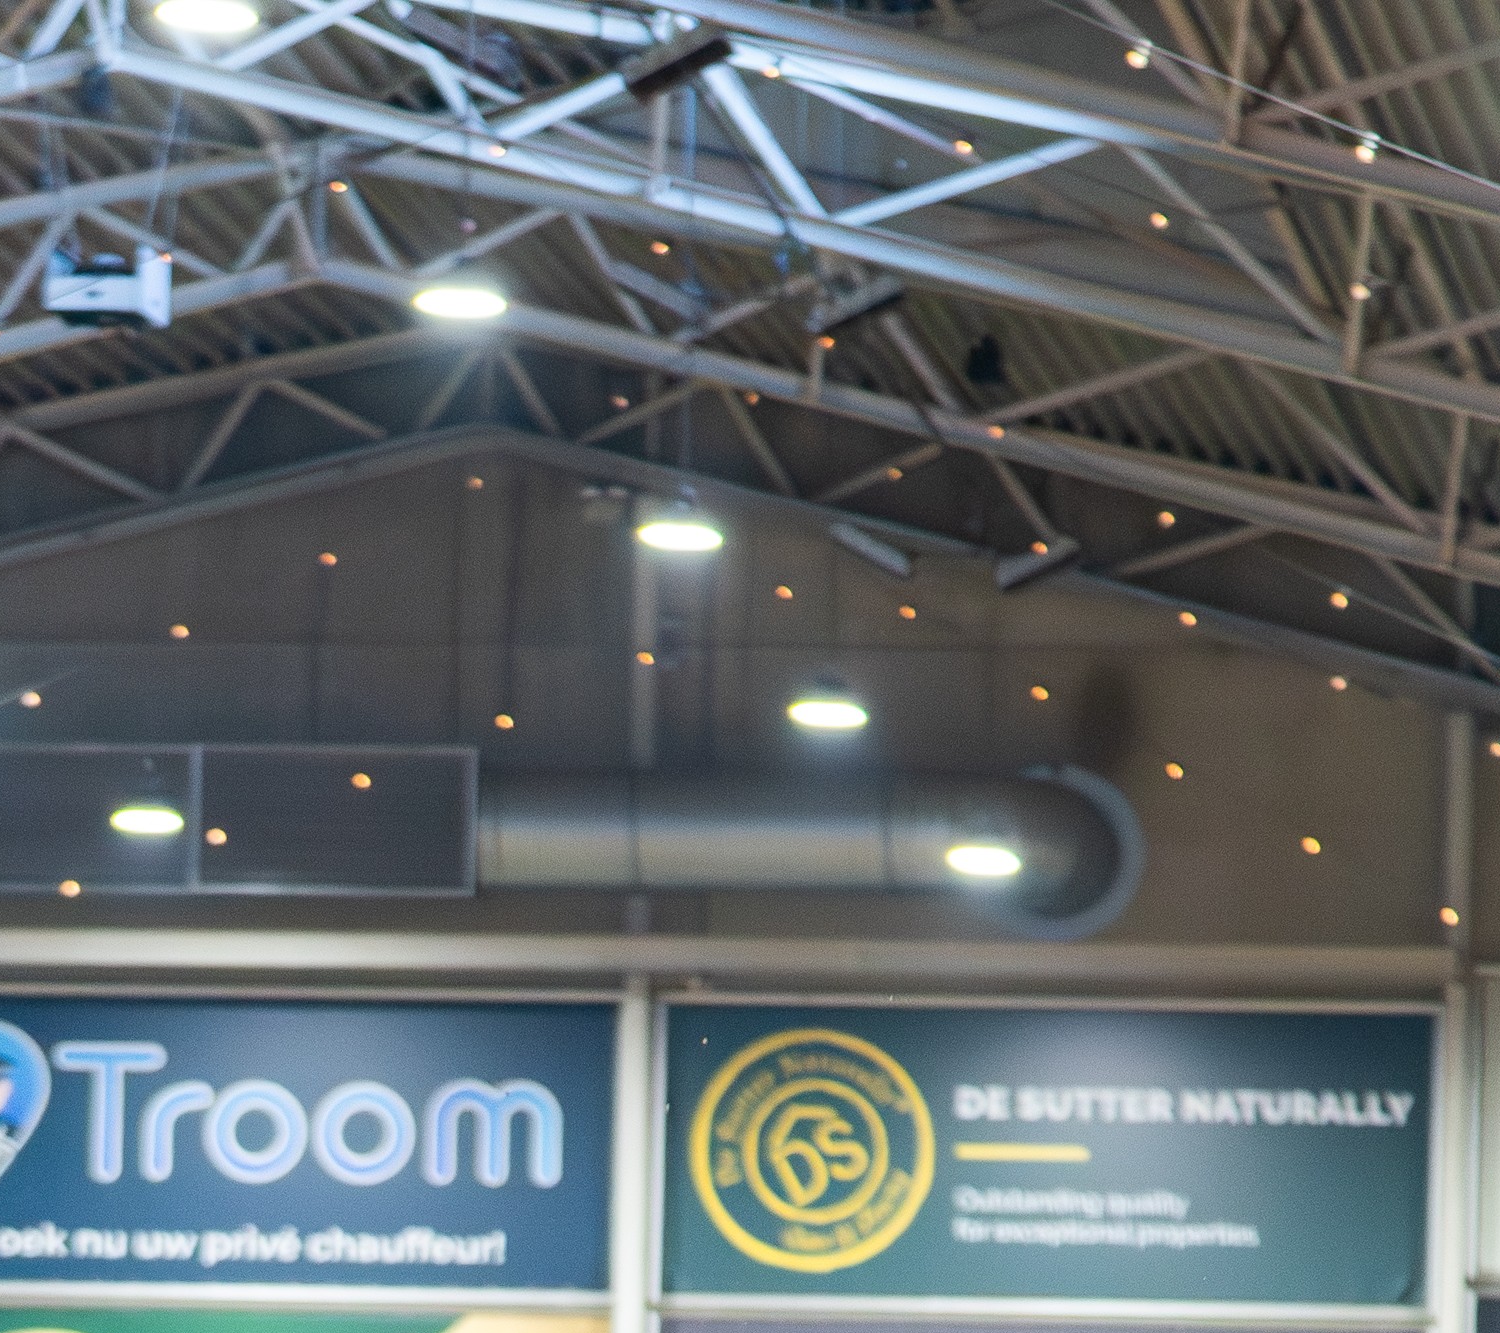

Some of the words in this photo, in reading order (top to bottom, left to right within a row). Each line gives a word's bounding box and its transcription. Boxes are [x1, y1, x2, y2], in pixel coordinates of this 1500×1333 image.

[53, 1040, 564, 1189] Troom
[953, 1084, 1013, 1123] DE
[1017, 1086, 1175, 1124] SUTTER
[1180, 1089, 1415, 1129] NATURALLY
[953, 1185, 1103, 1219] Outstanding
[1106, 1189, 1191, 1221] quality
[71, 1229, 130, 1261] nu
[136, 1230, 199, 1262] uw
[202, 1223, 301, 1268] privé
[304, 1225, 507, 1267] chauffeur!
